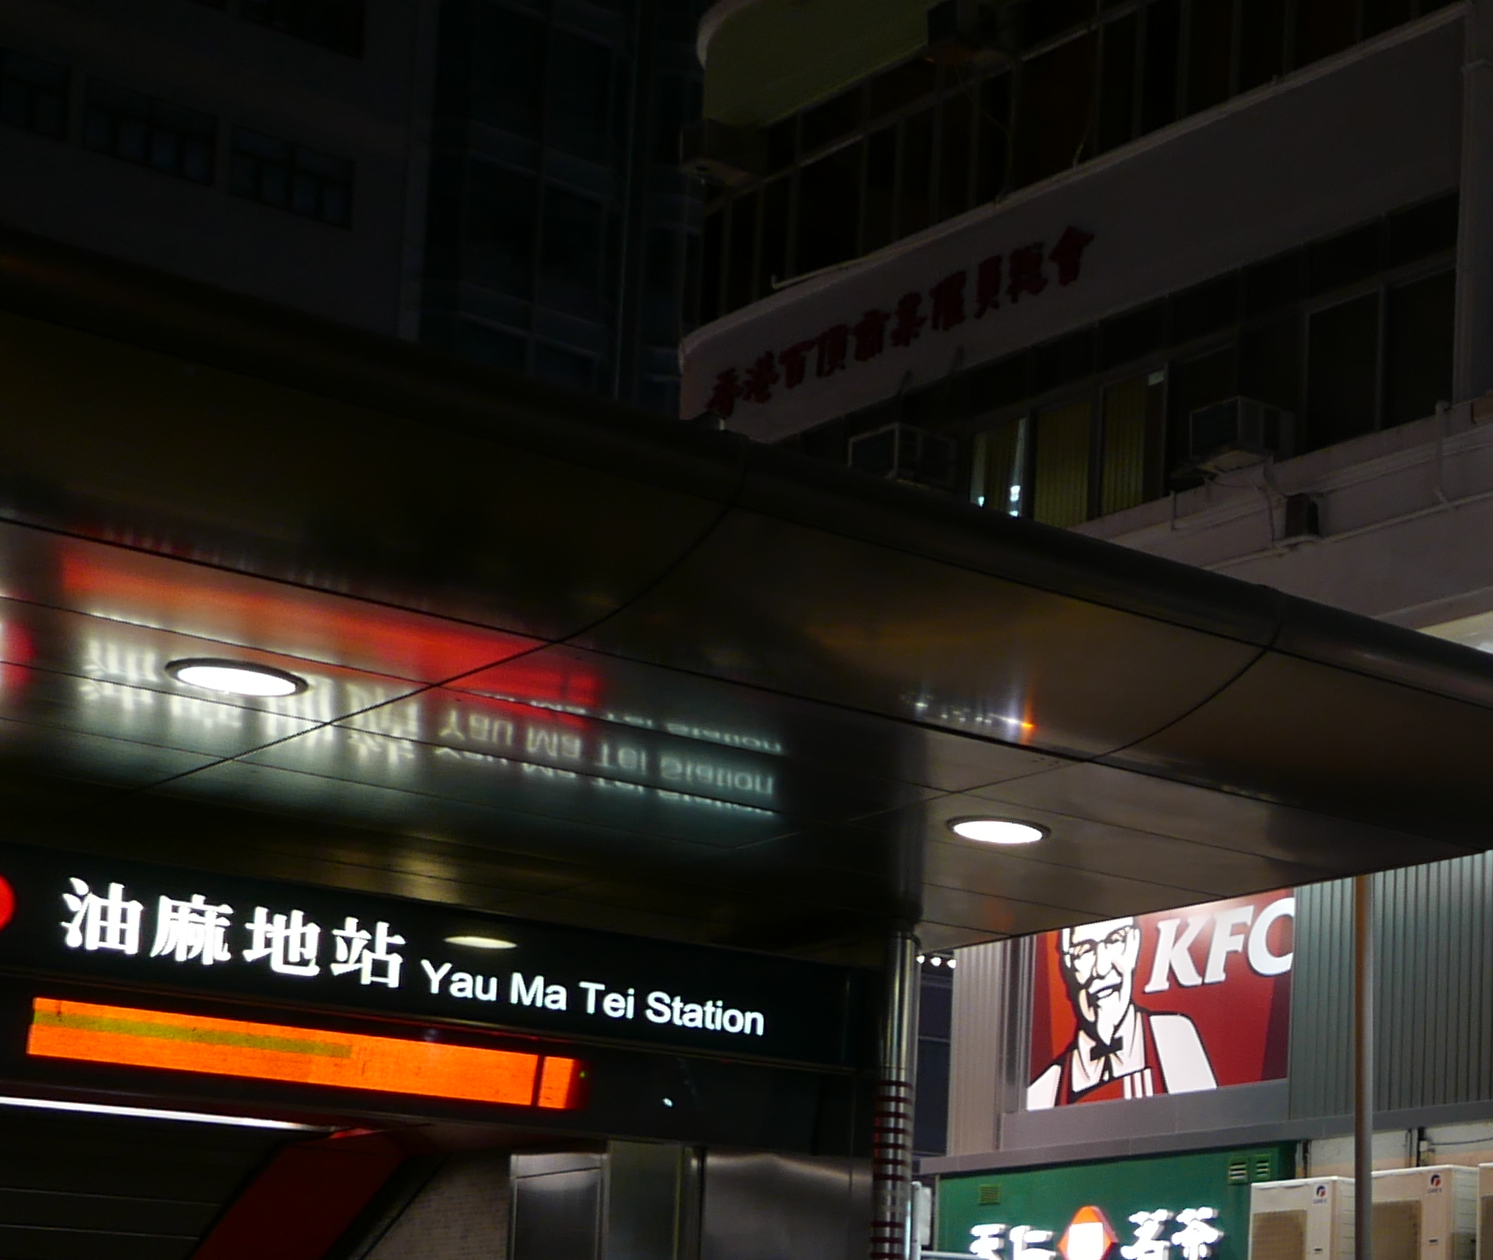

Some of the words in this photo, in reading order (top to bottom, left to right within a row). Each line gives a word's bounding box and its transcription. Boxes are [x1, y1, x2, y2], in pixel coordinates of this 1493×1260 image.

[62, 877, 405, 988] 油麻地站
[420, 960, 498, 1004] Yau
[510, 973, 567, 1011] Ma
[579, 983, 635, 1019] Tei
[645, 992, 765, 1036] Station
[1144, 897, 1294, 994] KFC
